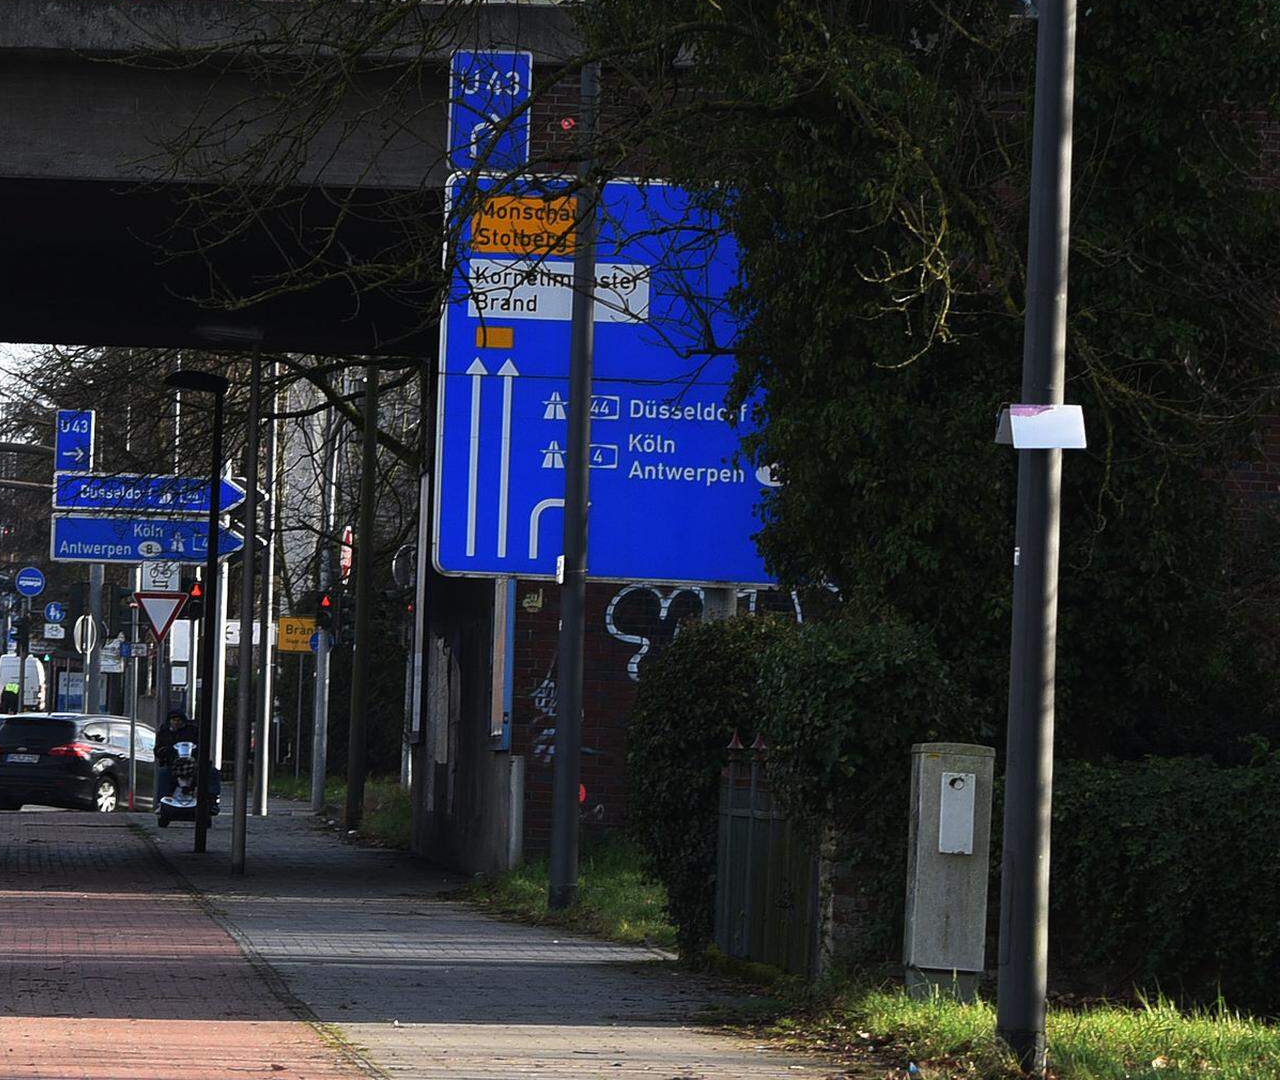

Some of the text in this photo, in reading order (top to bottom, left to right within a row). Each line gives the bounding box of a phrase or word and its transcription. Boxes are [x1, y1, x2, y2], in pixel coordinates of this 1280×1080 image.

[479, 228, 567, 253] Stolberg
[476, 265, 638, 290] Kornelimster
[476, 294, 537, 312] Brand
[591, 399, 748, 422] 44 Düsseldof
[629, 434, 676, 454] Köln
[593, 450, 745, 486] 4 Antwerpen
[134, 524, 164, 538] Köln
[60, 541, 132, 557] Antwerpen
[286, 624, 314, 635] Bran
